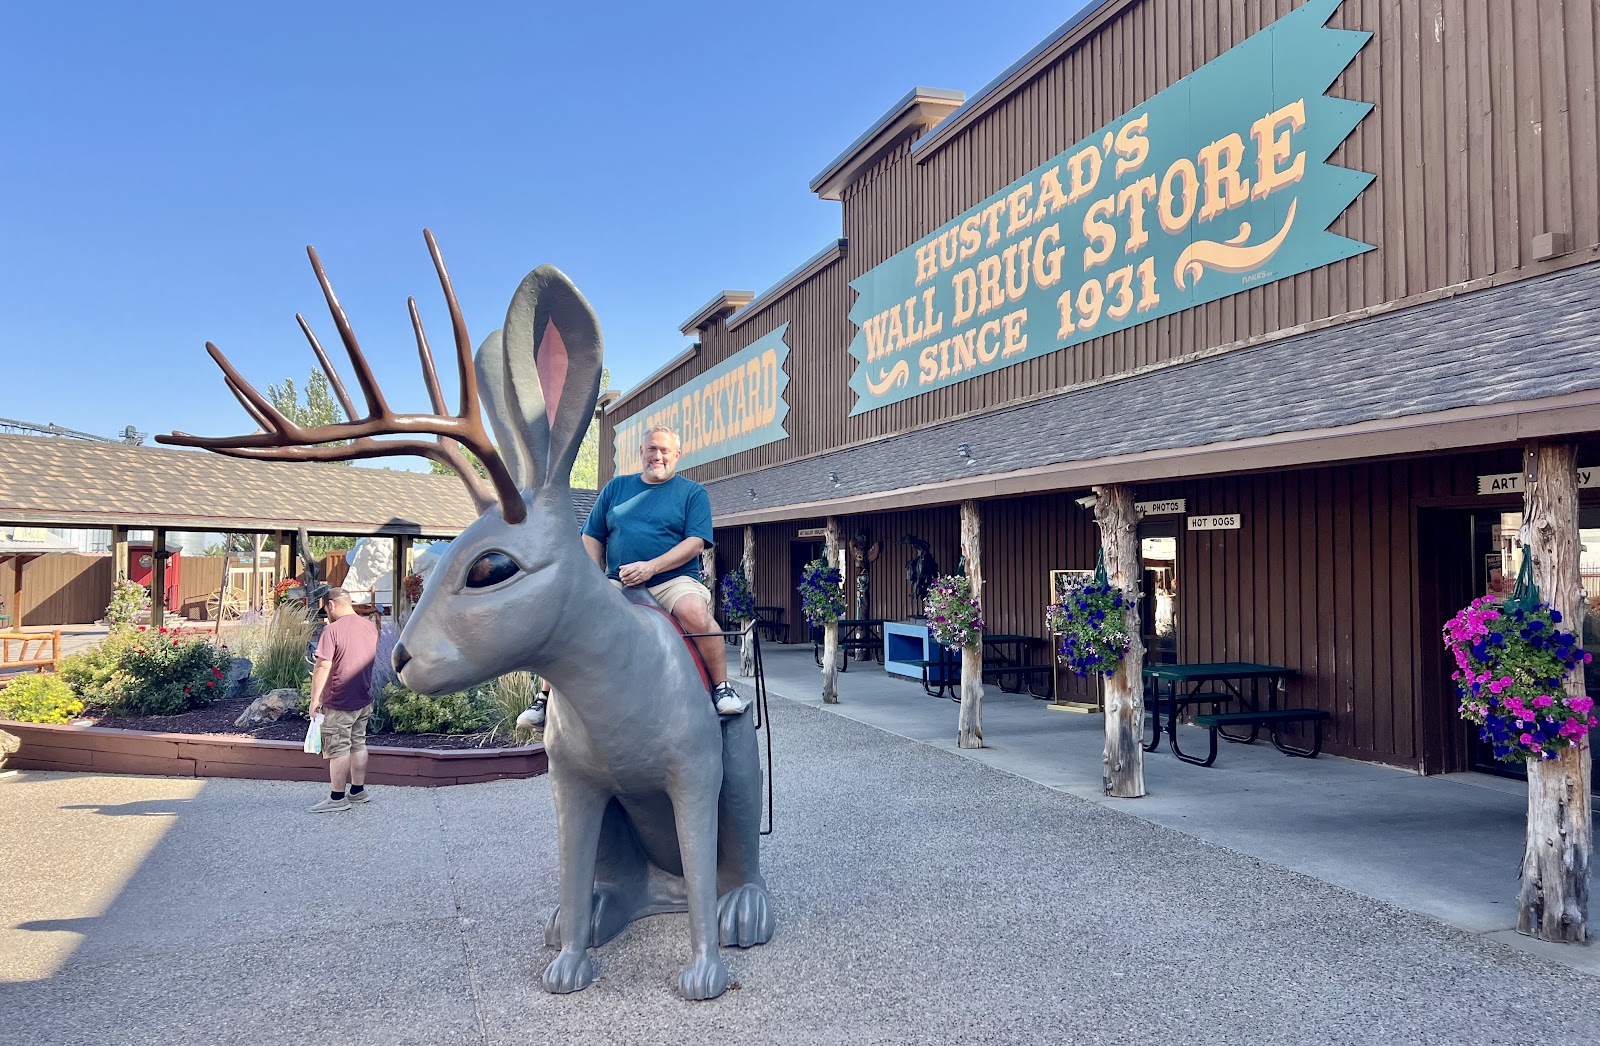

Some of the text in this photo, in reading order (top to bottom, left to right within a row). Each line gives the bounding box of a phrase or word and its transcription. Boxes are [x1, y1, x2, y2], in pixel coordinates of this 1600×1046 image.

[863, 98, 1306, 363] WALL DRUG STORE
[915, 112, 1150, 286] HUSTEAD'S
[919, 256, 1160, 386] SINCE 1931
[682, 349, 777, 457] BACKYARD
[1152, 502, 1179, 512] PHOTOS
[1192, 517, 1235, 527] HOT DOGS
[1491, 477, 1518, 490] ART
